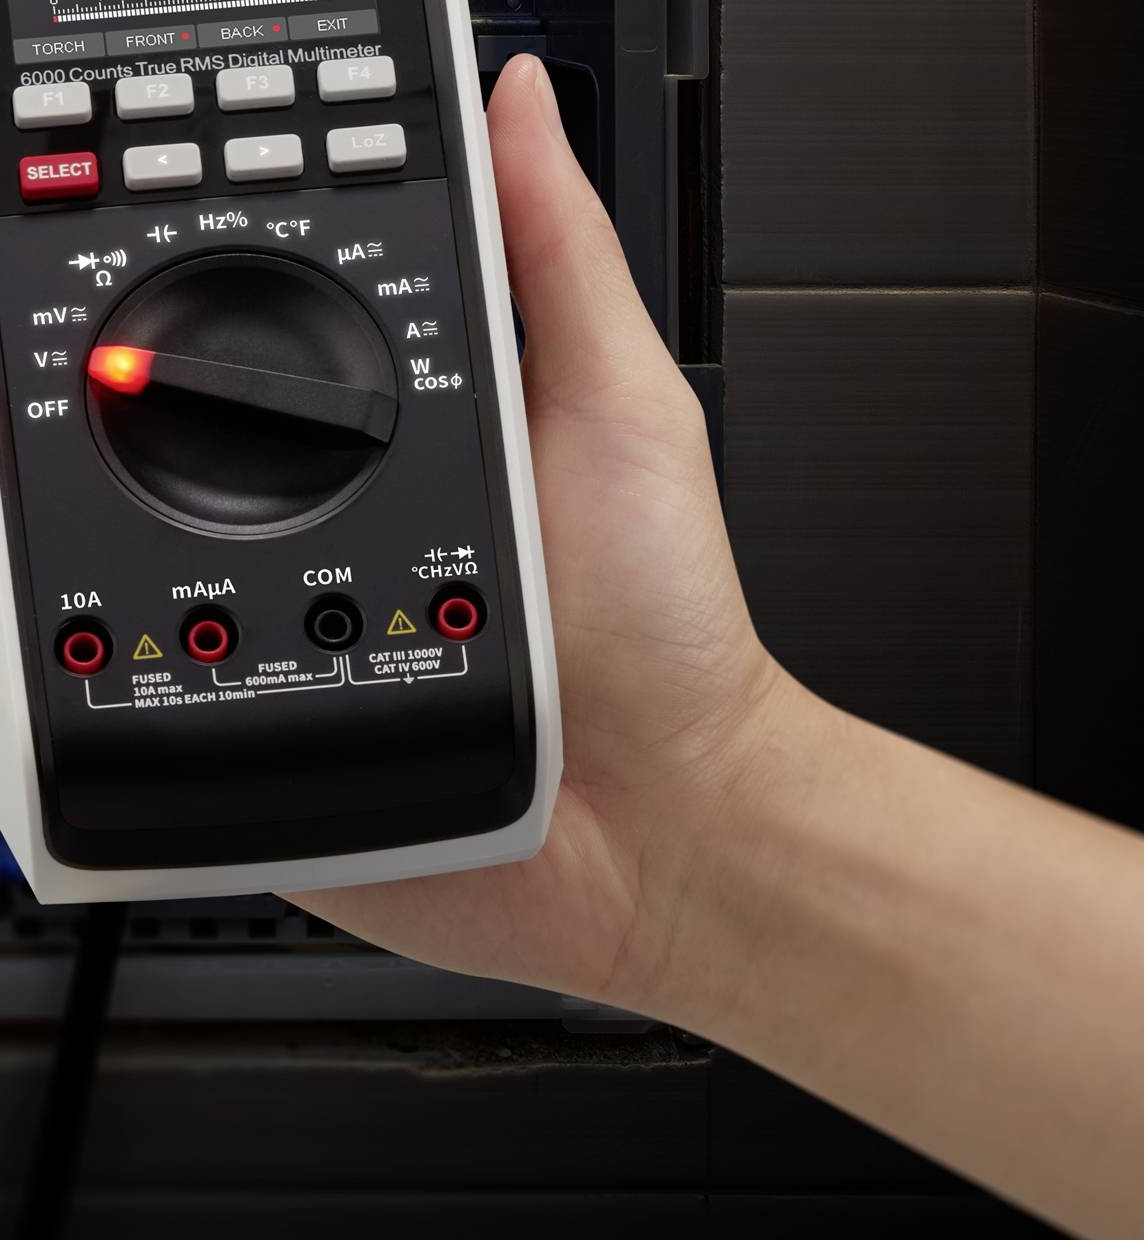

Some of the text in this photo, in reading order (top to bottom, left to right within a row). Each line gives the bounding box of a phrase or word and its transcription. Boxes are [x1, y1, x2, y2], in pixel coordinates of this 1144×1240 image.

[32, 18, 348, 55] TORCH FRONT BACK EXIT
[20, 44, 382, 86] 6000 Counts True RMS Digital Multimeter
[348, 66, 371, 80] F4
[146, 83, 169, 99] F2
[246, 75, 269, 90] F3
[42, 92, 64, 106] F1
[352, 132, 387, 151] LoZ
[27, 161, 92, 180] SELECT
[199, 211, 248, 231] Hz%
[377, 278, 413, 296] mA
[32, 307, 67, 325] mV
[410, 358, 430, 375] W
[27, 400, 69, 419] OFF
[303, 567, 352, 586] COM
[61, 591, 102, 611] 10A
[369, 648, 443, 663] CAT III 1000V
[258, 661, 298, 673] FUSED
[374, 660, 440, 674] CAT IV 600V
[132, 672, 172, 685] FUSED
[245, 672, 314, 687] 600mA max
[133, 685, 183, 697] 10A max
[135, 689, 256, 709] MAX 10s EACH 10min
